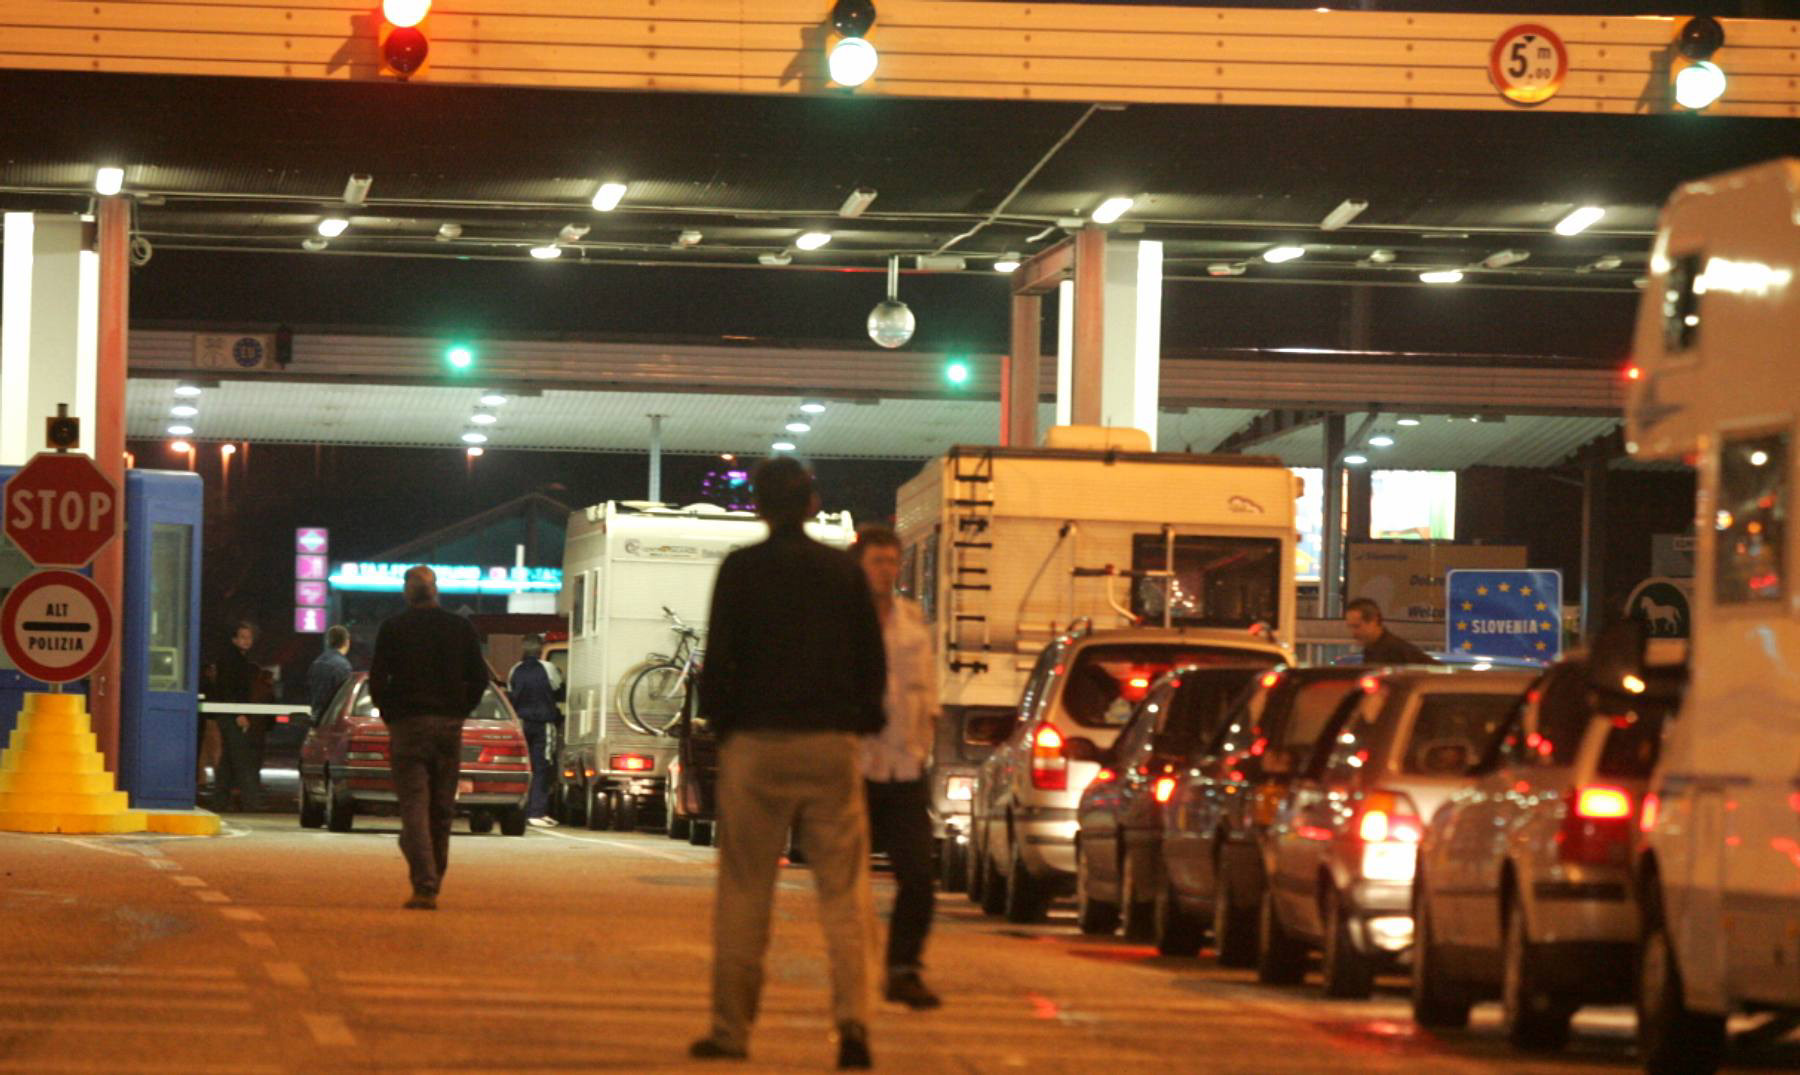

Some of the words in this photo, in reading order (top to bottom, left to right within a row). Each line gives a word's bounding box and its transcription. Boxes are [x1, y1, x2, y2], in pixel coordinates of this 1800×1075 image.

[12, 489, 112, 531] STOP
[46, 603, 69, 617] ALT
[1471, 619, 1538, 634] SLOVENIA
[28, 636, 84, 651] POLIZIA
